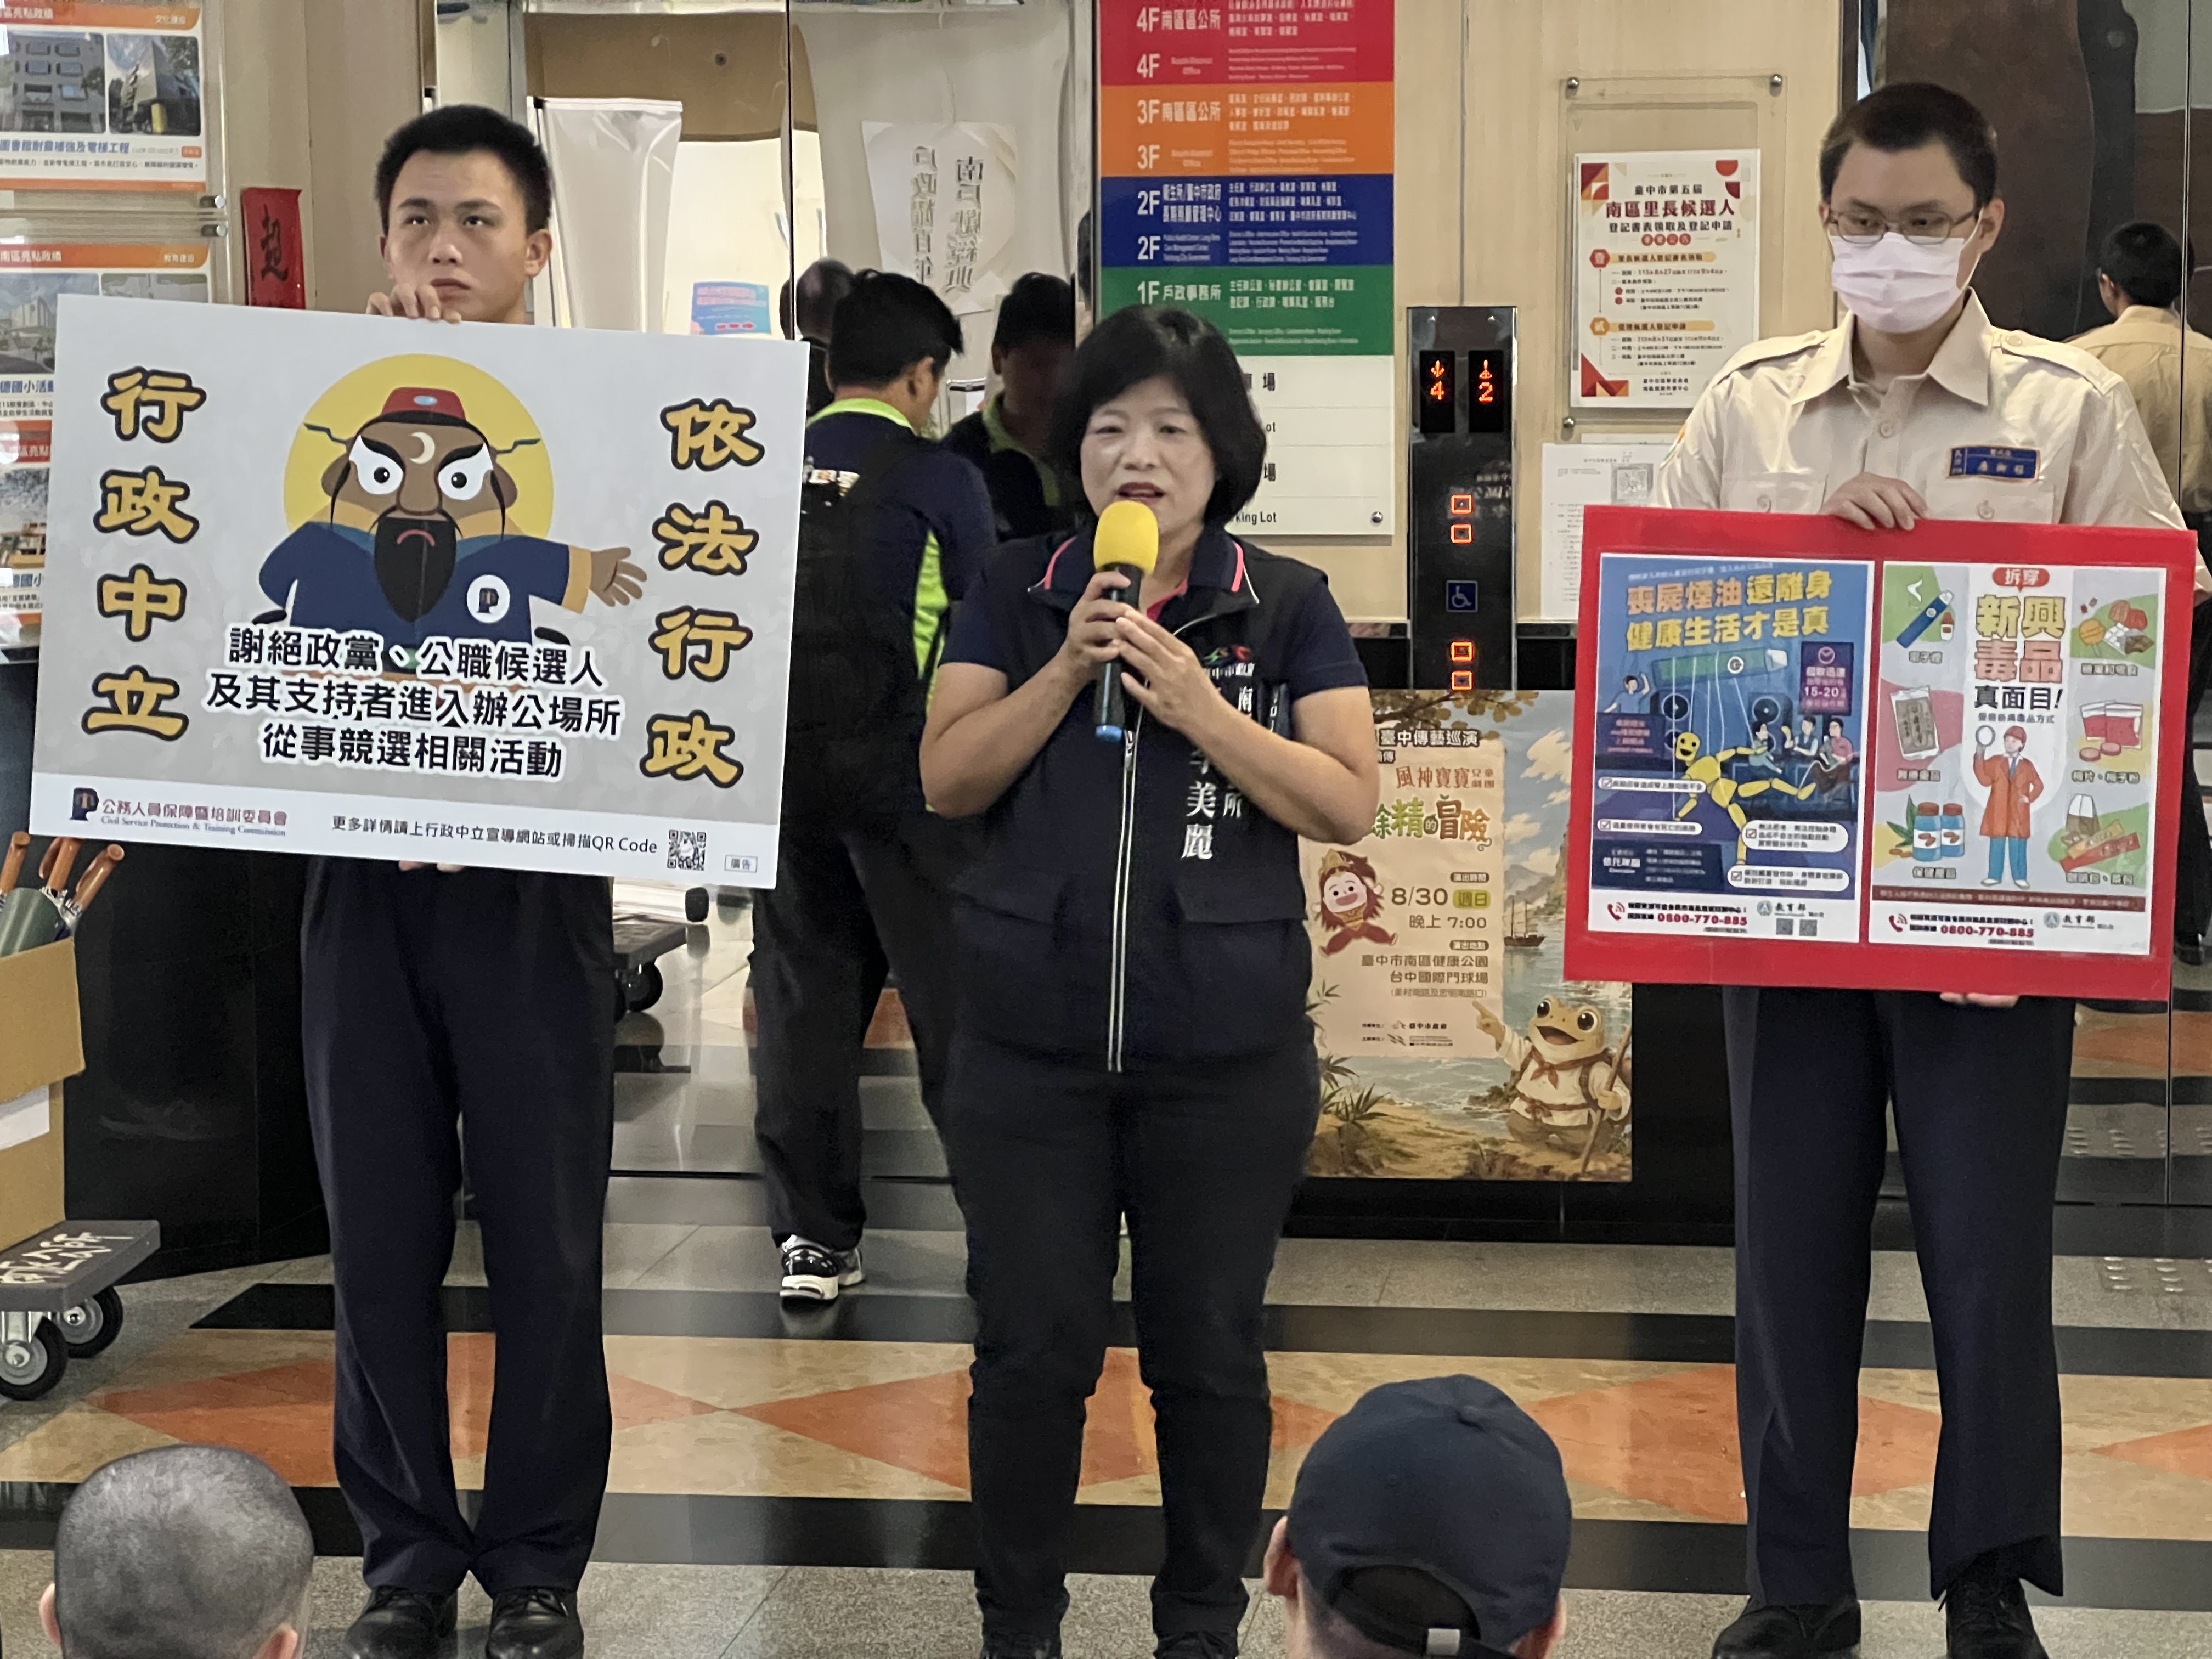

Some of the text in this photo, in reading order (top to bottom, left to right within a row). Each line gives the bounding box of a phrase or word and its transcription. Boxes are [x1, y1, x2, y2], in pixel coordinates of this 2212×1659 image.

[1136, 7, 1160, 33] 4F
[1136, 53, 1160, 78] 4F
[1137, 99, 1160, 125] 3F
[1137, 144, 1160, 170] 3F
[1137, 190, 1160, 215] 2F
[1606, 199, 1735, 218] 南區里長候選人
[1137, 236, 1161, 261] 2F
[1137, 280, 1160, 304] 1F
[1430, 380, 1444, 400] 4
[1479, 382, 1493, 402] 2
[1235, 511, 1277, 526] king Lot
[82, 366, 207, 742] 行政中立
[640, 398, 765, 788] 依法行政
[1627, 569, 1832, 616] 喪屍煙油遠離身
[1627, 606, 1829, 651] 健康生活才是真
[1976, 594, 2066, 639] 新興
[229, 627, 603, 687] 謝絕政黨、公職候選人
[1974, 638, 2063, 683] 毒品
[1805, 686, 1839, 697] 15-20
[1975, 685, 2063, 710] 真面目!
[207, 673, 621, 736] 及其支持者進入辦公場所
[1380, 729, 1479, 747] 臺中傳藝巡演
[263, 724, 562, 778] 從事競選相關活動
[1396, 766, 1470, 789] 風神寶寶
[103, 799, 287, 826] 公務人員保障暨培訓委員會
[101, 816, 120, 825] Civil
[122, 817, 148, 827] Service
[150, 819, 190, 830] Protection
[205, 823, 235, 834] Training
[238, 825, 286, 836] Commission
[618, 837, 657, 854] Code
[1391, 886, 1487, 907] 8/30 週日
[1409, 914, 1487, 929] 晚上 7:00
[1657, 912, 1747, 926] 0800-770-885
[1362, 955, 1488, 967] 臺中市南區健康公園
[1390, 970, 1488, 984] 台中國際門球場
